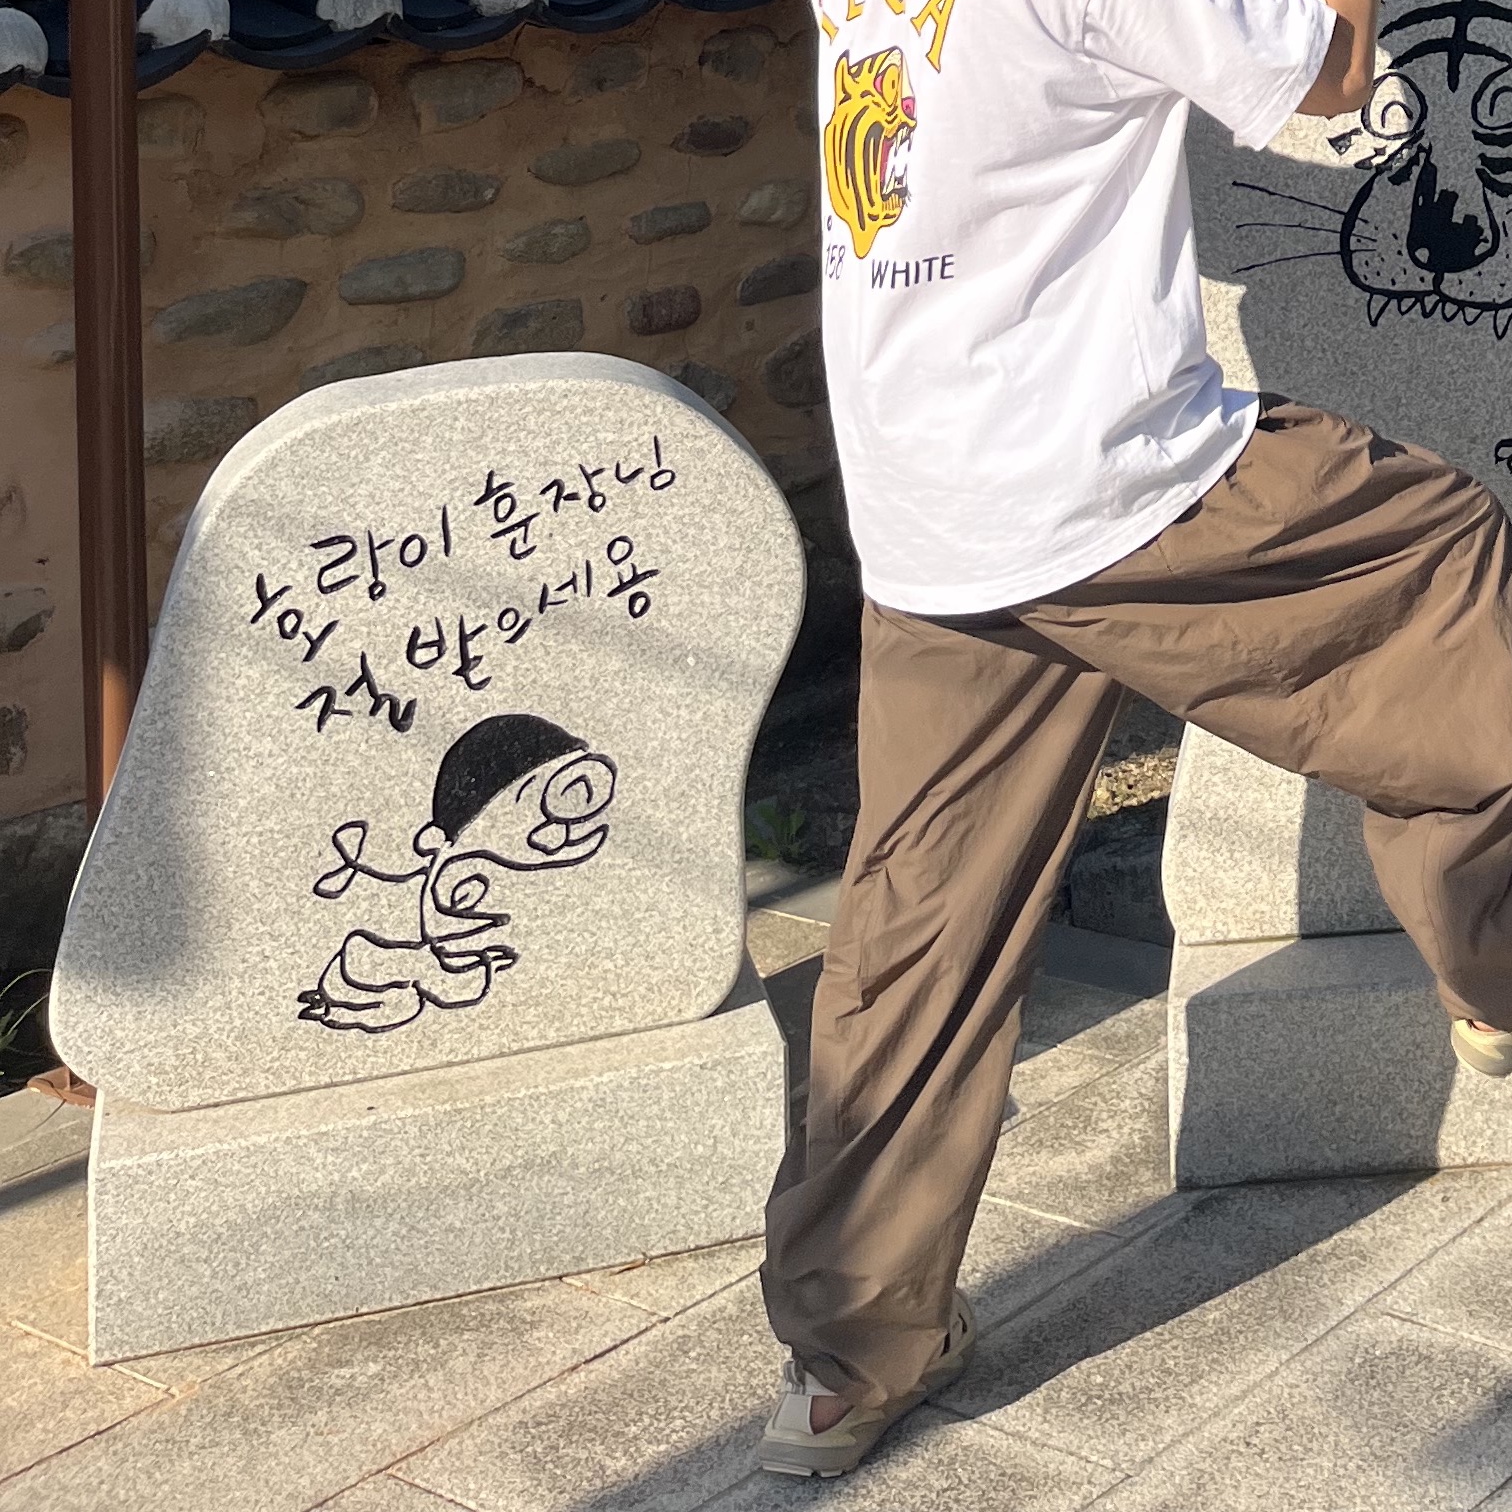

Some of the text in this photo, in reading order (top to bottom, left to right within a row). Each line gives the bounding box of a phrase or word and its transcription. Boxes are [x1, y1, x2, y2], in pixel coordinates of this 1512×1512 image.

[871, 253, 955, 289] WHITE
[250, 434, 677, 663] 호랑이 훈장님
[294, 534, 661, 733] 절 받으세용
